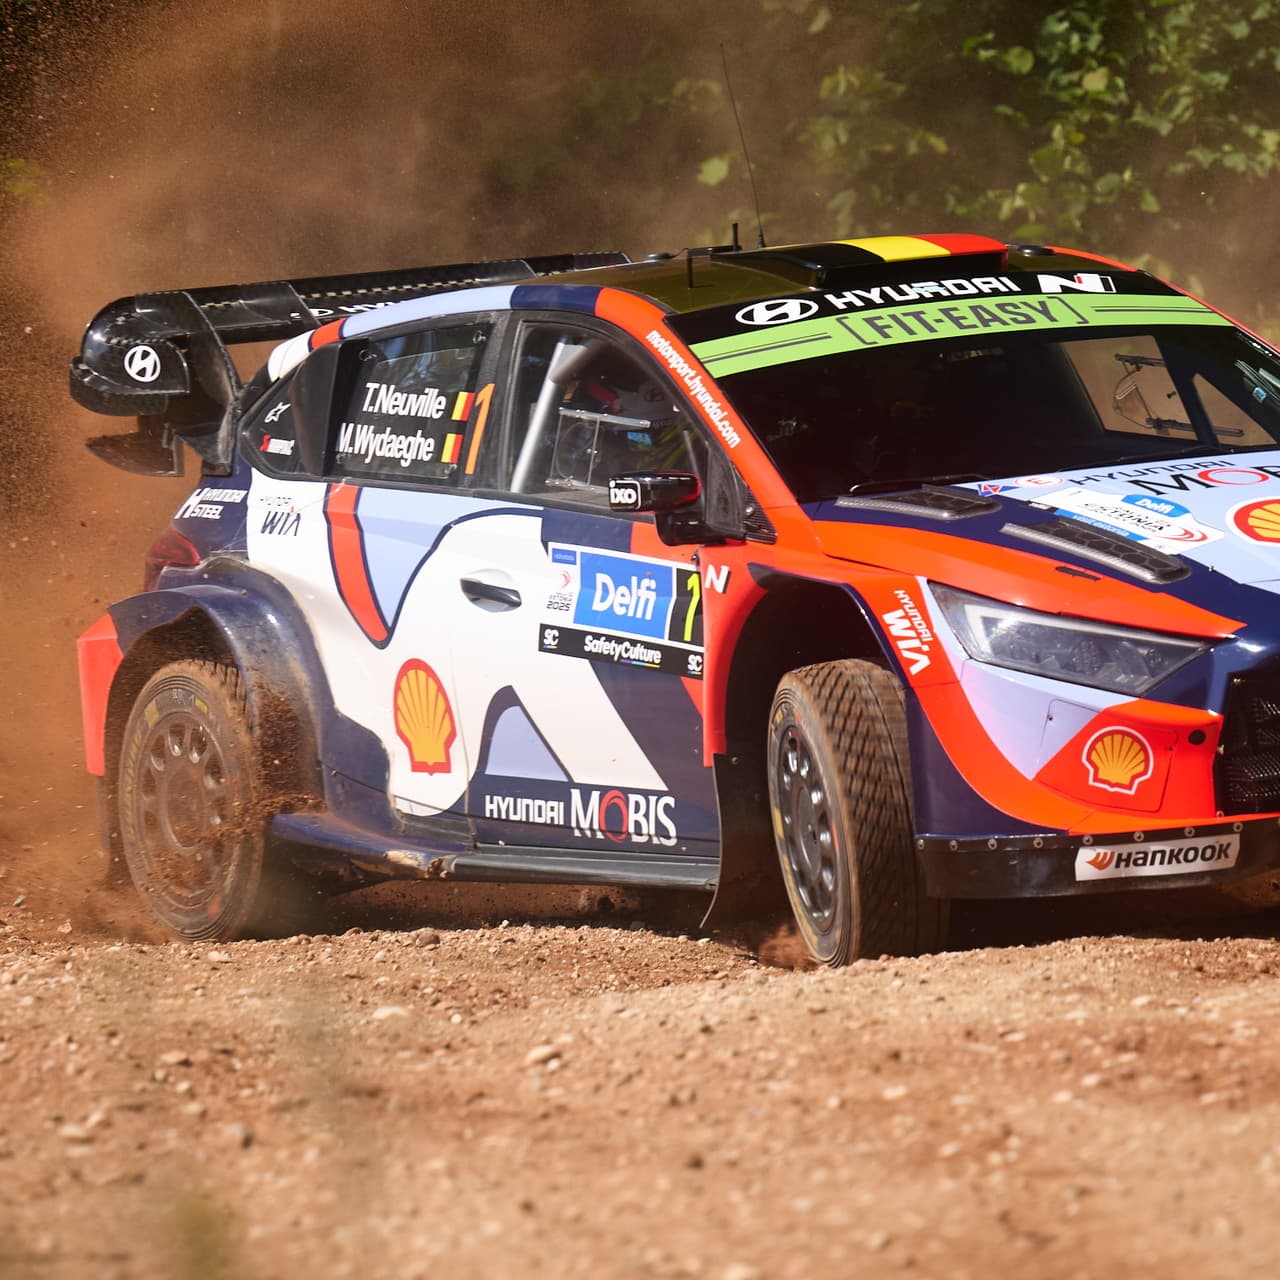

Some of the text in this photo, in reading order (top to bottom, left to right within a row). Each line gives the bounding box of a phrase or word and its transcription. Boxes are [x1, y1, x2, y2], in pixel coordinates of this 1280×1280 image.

[824, 276, 1022, 310] HYUNDAI
[362, 382, 447, 419] T.Neuville
[645, 329, 741, 448] motorsport.hyundai.com
[338, 422, 436, 468] M.Wydaeghe
[464, 383, 496, 475] 1
[1068, 460, 1236, 485] HYUNDAI
[190, 504, 224, 520] STEEL
[1135, 497, 1176, 514] Delfi
[546, 600, 572, 612] 2025
[591, 572, 657, 621] Delfi
[683, 572, 701, 642] 1
[893, 589, 934, 642] HYUNDAI
[543, 628, 704, 672] SC SafetyCulture SC
[882, 608, 932, 676] WIA
[485, 788, 678, 847] HYUNDAI MOBIS
